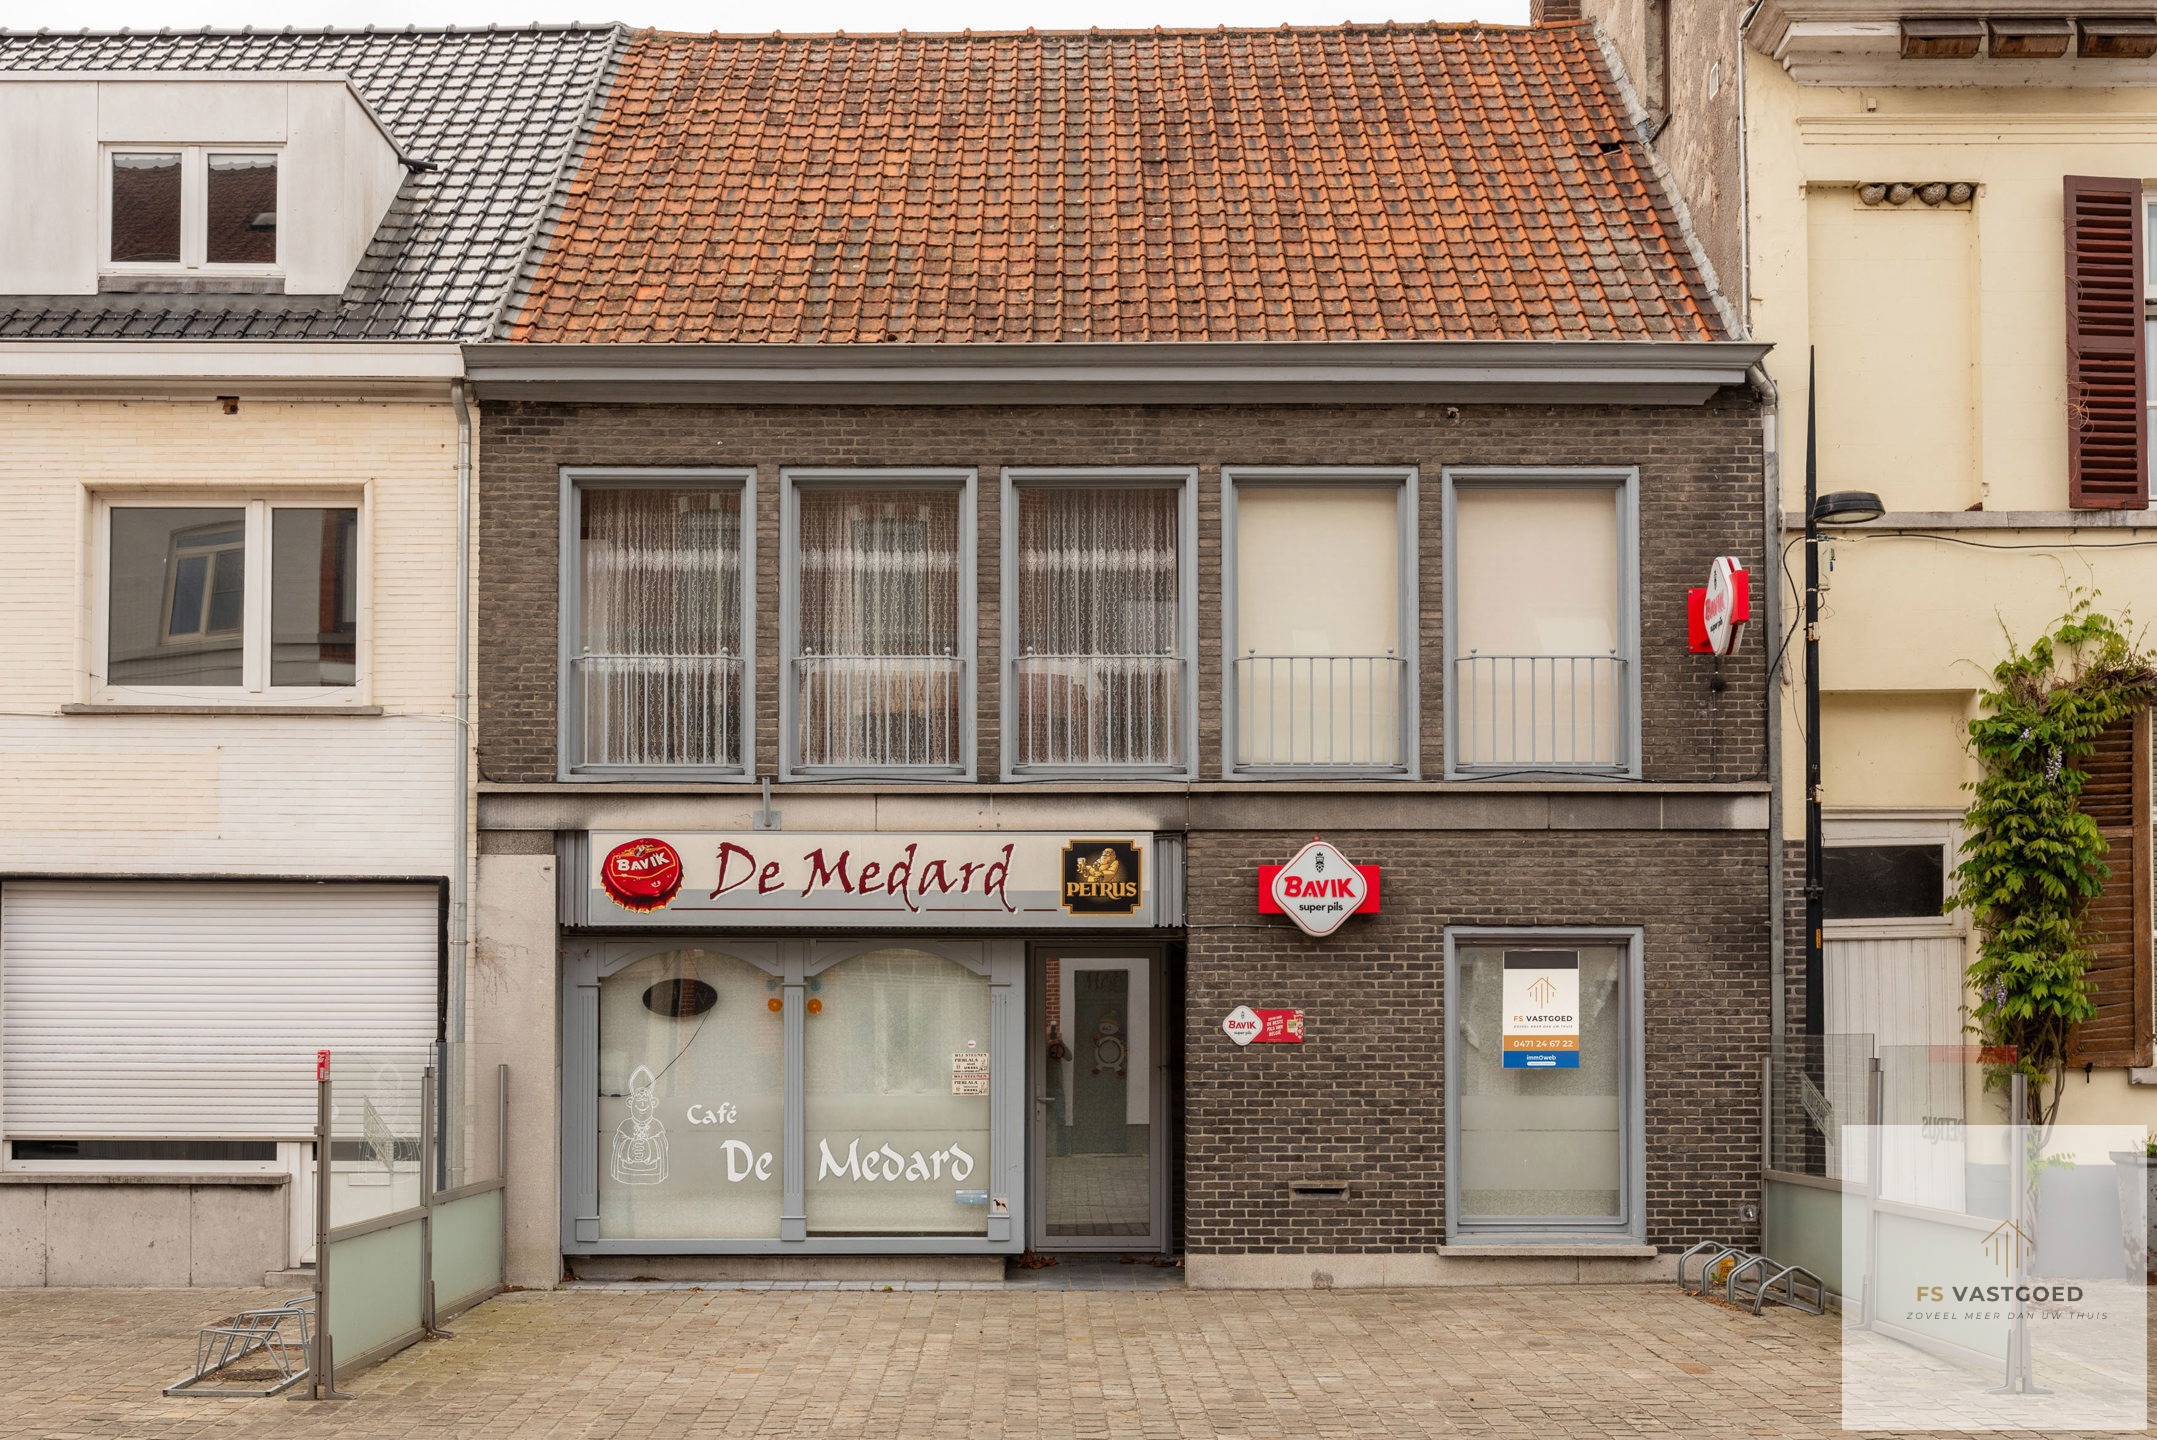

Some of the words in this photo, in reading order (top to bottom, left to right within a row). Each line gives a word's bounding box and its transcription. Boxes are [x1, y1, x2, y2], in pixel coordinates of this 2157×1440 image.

[1705, 590, 1724, 620] BAVIK
[616, 852, 670, 871] BAVIK
[709, 842, 785, 900] De
[800, 843, 1018, 914] Medard
[1284, 875, 1356, 898] BAVIK
[1066, 882, 1137, 900] PETRUS
[1299, 903, 1326, 913] super
[1327, 901, 1343, 913] pils
[1228, 1020, 1256, 1029] BAVIK
[686, 1102, 738, 1125] Café
[720, 1139, 773, 1182] De
[818, 1137, 974, 1182] Medard
